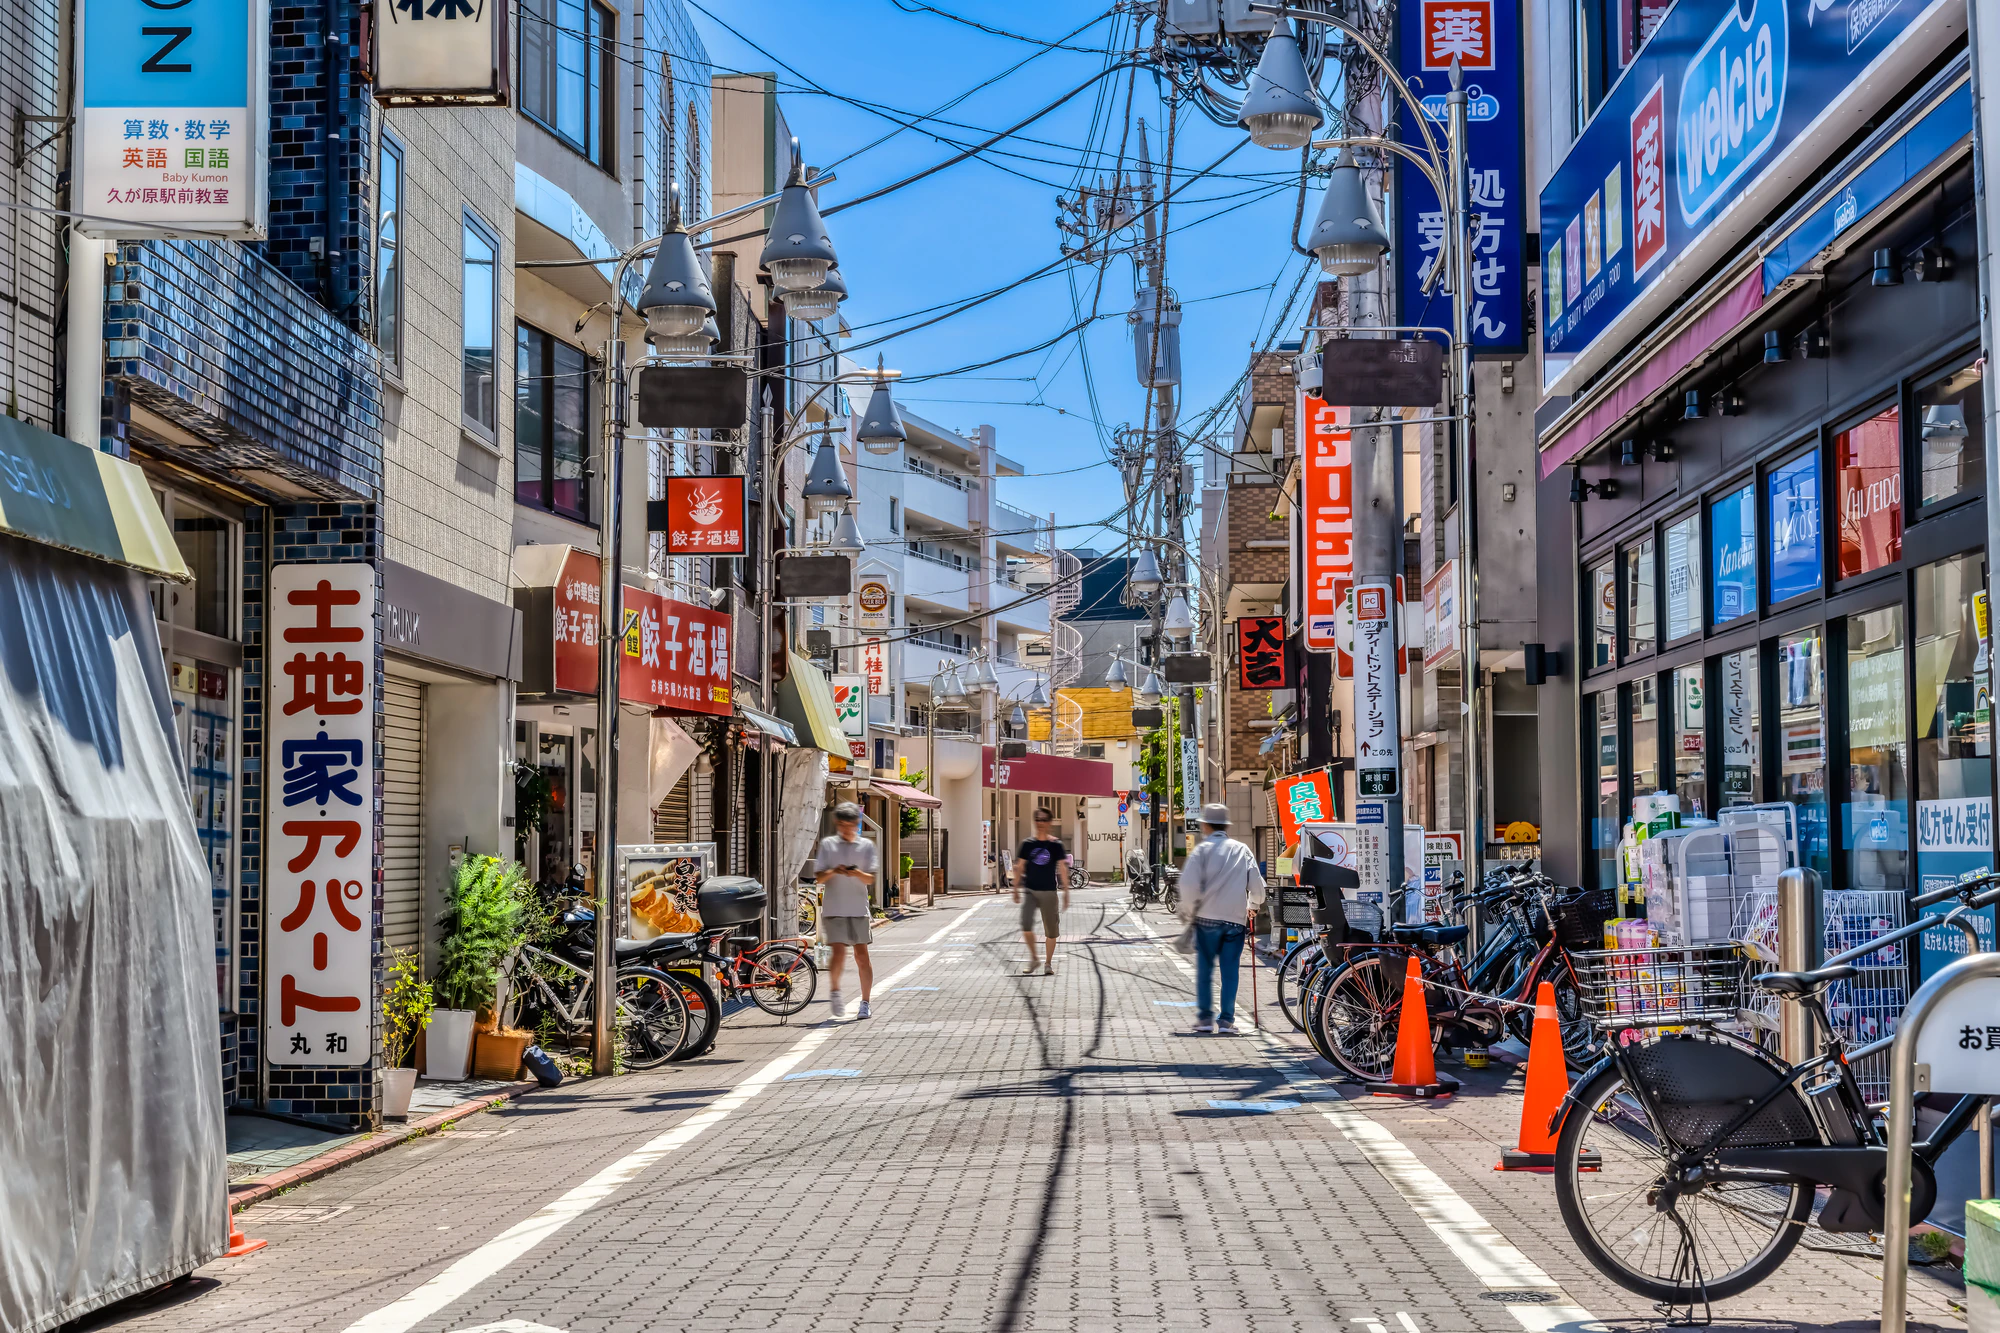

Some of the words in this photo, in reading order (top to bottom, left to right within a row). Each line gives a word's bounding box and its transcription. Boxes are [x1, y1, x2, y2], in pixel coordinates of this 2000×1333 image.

[1432, 9, 1484, 59] 薬
[123, 119, 230, 140] 算数・数学
[1684, 22, 1773, 195] welcia
[122, 147, 168, 169] 英語
[184, 148, 230, 169] 国語
[162, 172, 188, 184] Baby
[191, 172, 229, 183] Kumon
[106, 187, 230, 204] 久が原駅前教室
[1636, 114, 1662, 250] 薬
[1469, 167, 1507, 339] 処方せん
[1549, 324, 1563, 352] HEALTH
[1567, 303, 1582, 333] BEAUTY
[1582, 279, 1606, 316] HOUSEHOLD
[1608, 262, 1621, 288] FOOD
[1314, 406, 1353, 600] クリーニング
[1841, 473, 1900, 529] SHISEIDO
[671, 530, 740, 546] 餃子酒場
[1719, 542, 1753, 578] Kanebo
[1365, 597, 1376, 605] PC
[387, 604, 420, 646] TRUNK
[640, 604, 729, 682] 餃子酒場
[1355, 620, 1389, 630] パソコン教室
[864, 637, 884, 695] 月桂冠
[1364, 629, 1384, 738] ディードットステーション
[1371, 748, 1394, 757] この先
[282, 579, 364, 1027] 土地・家・アパート
[1288, 781, 1324, 835] 良質
[1372, 783, 1384, 792] 30
[1919, 802, 1991, 847] 処方せん受付
[1372, 835, 1380, 885] 放置されている
[289, 1032, 348, 1055] 丸和
